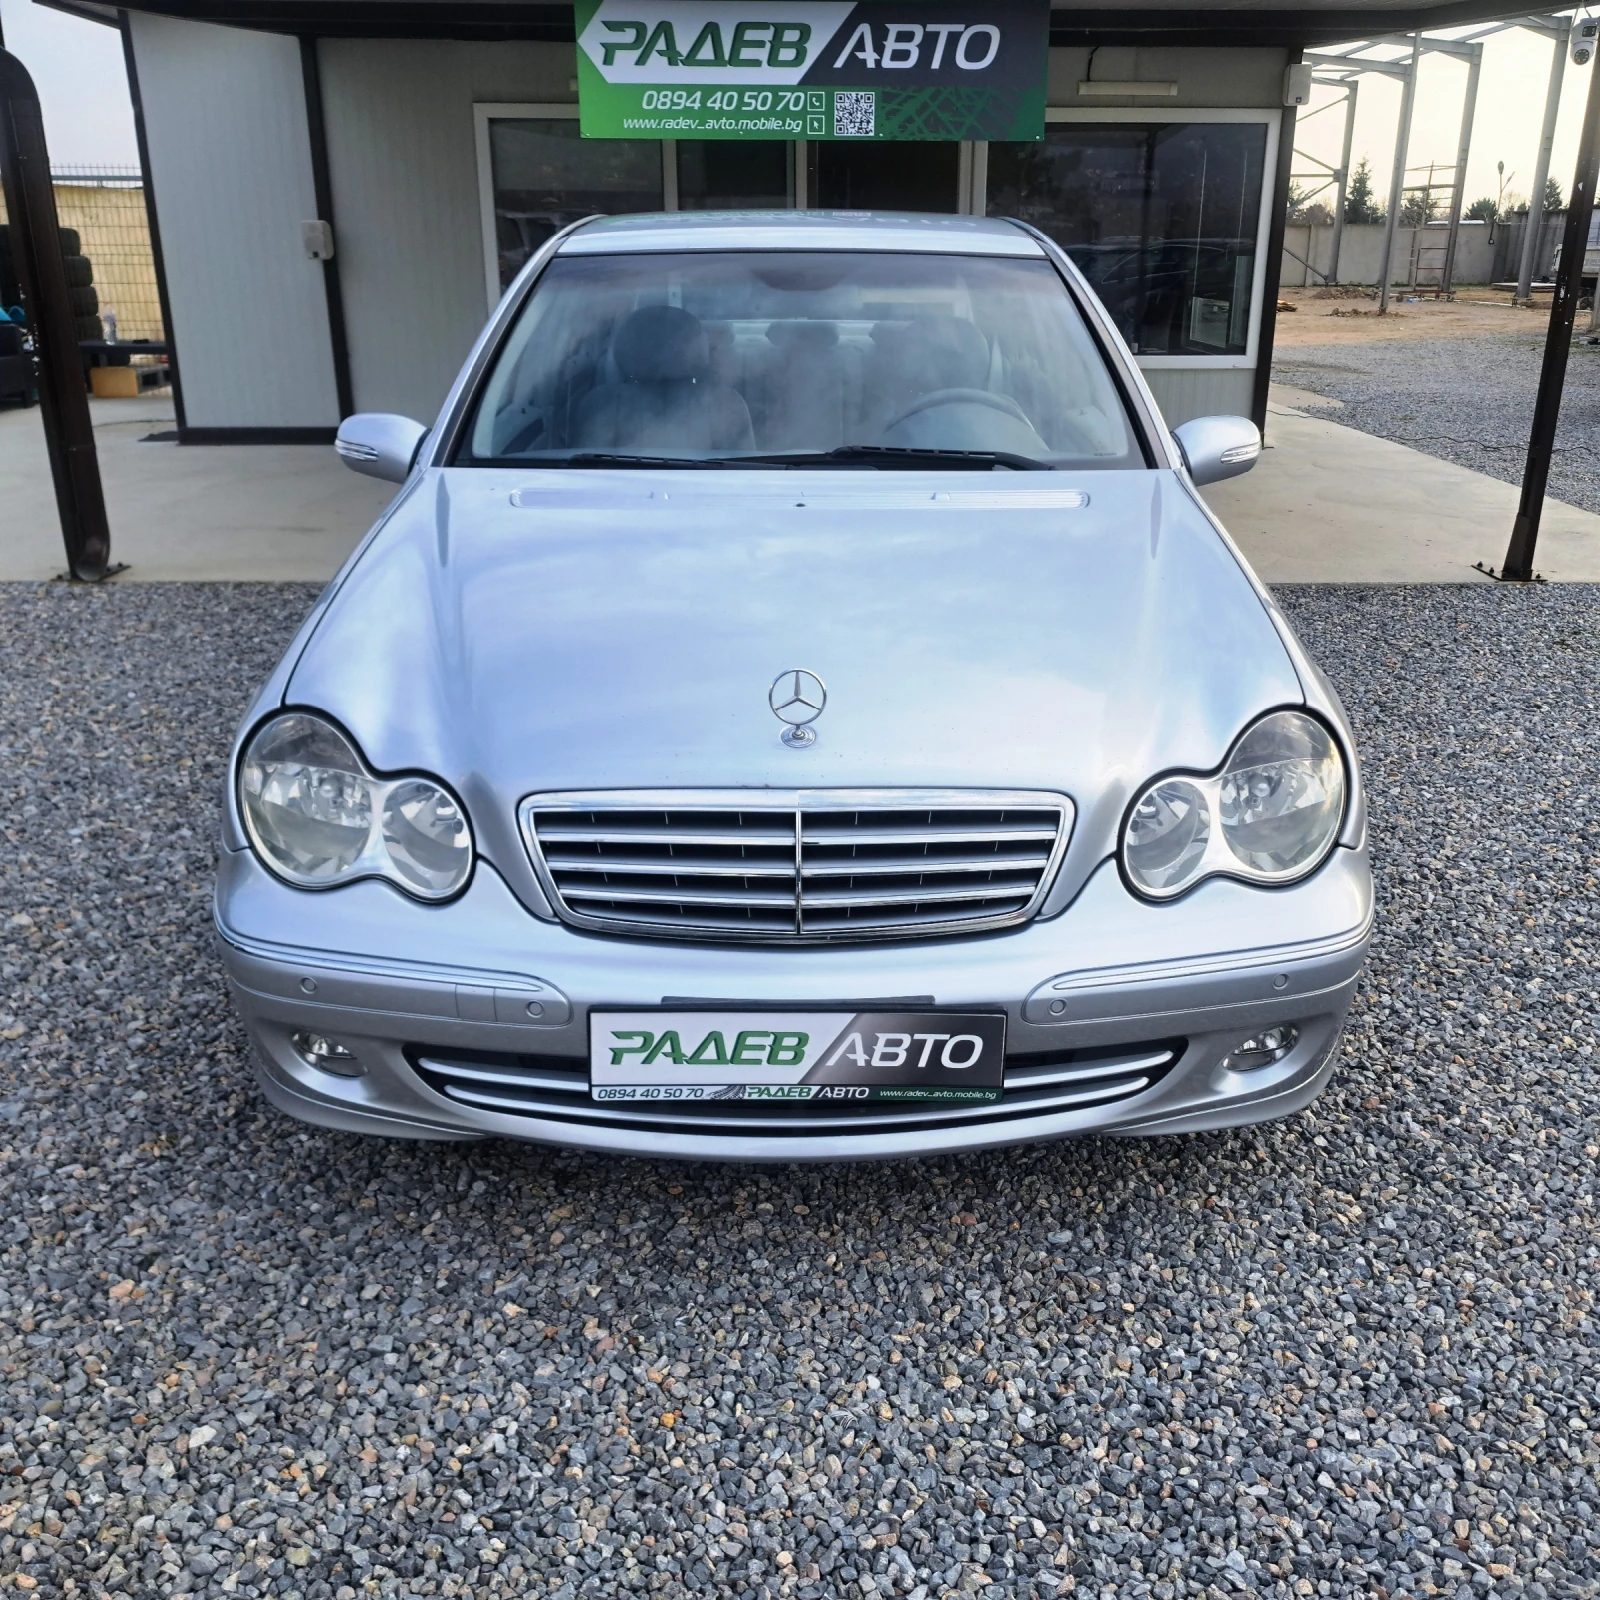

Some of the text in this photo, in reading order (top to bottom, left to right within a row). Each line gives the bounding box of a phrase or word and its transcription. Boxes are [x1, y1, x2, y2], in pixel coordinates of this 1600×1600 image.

[600, 20, 1001, 71] РАДЕВ АВТО
[642, 91, 804, 111] 0894 40 50 70
[623, 117, 803, 133] www.radev_avto.mobile.bg
[608, 1030, 983, 1069] РАДЕВ АВТО
[598, 1088, 704, 1099] 0894 40 50 70
[747, 1086, 869, 1099] РАДЕВ АВТО
[880, 1089, 997, 1099] www.radev_avto.mobile.bg
